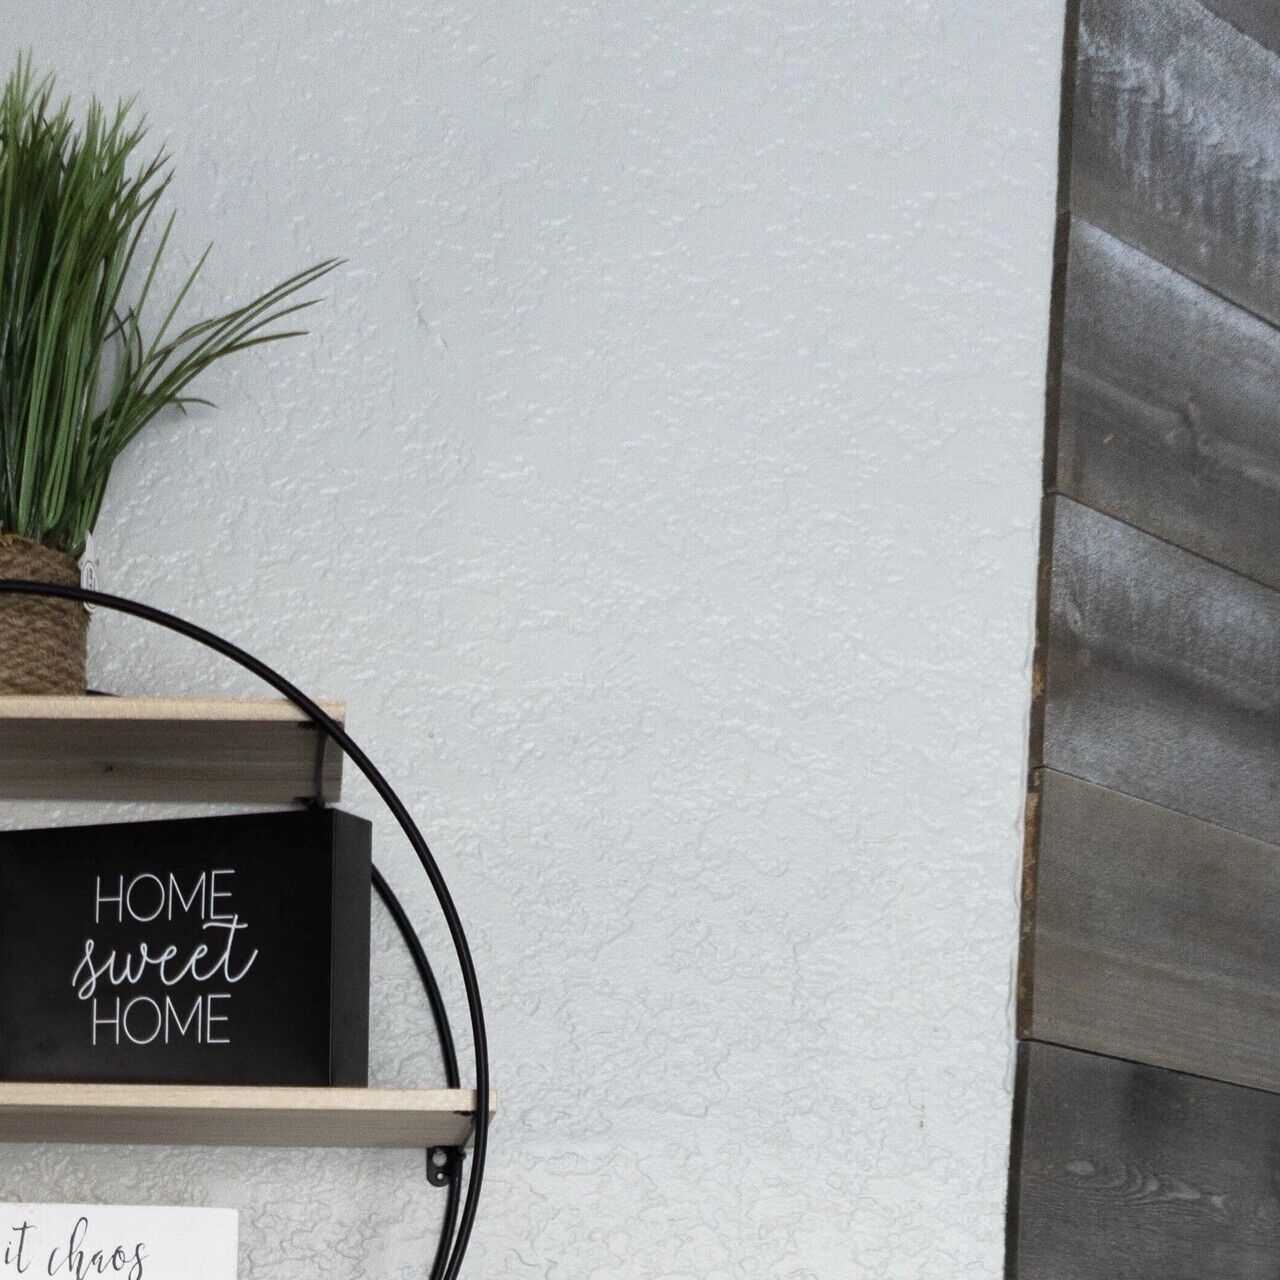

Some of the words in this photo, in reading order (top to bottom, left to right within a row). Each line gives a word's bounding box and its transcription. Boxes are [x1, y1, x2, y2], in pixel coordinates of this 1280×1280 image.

[95, 869, 236, 924] HOME
[72, 914, 259, 1000] sweet
[92, 993, 232, 1046] HOME
[3, 1219, 37, 1275] it
